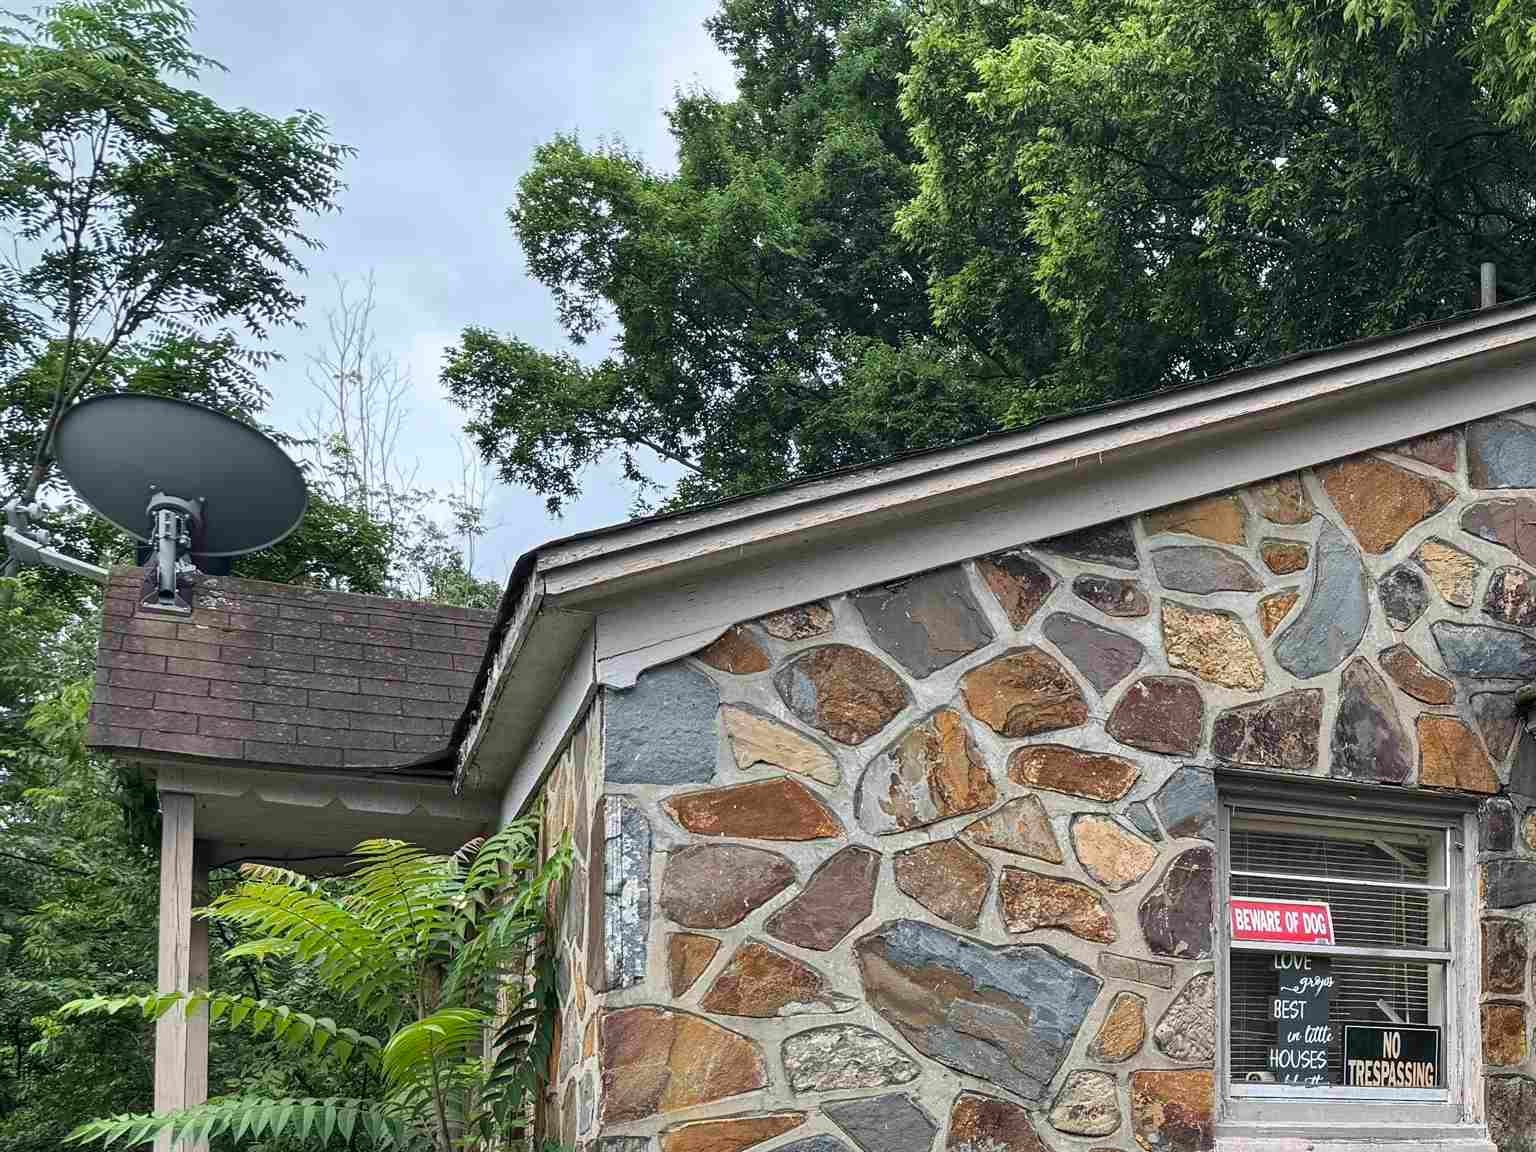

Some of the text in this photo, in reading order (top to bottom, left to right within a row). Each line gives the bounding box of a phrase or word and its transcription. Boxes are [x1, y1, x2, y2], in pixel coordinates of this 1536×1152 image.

[1234, 908, 1327, 935] BEWARE OF DOG
[1274, 952, 1312, 970] LOVE
[1273, 999, 1307, 1019] BEST
[1287, 1024, 1334, 1044] in little
[1382, 1031, 1401, 1059] NO
[1270, 1048, 1327, 1069] HOUSES
[1347, 1059, 1434, 1088] TRESPASSING
